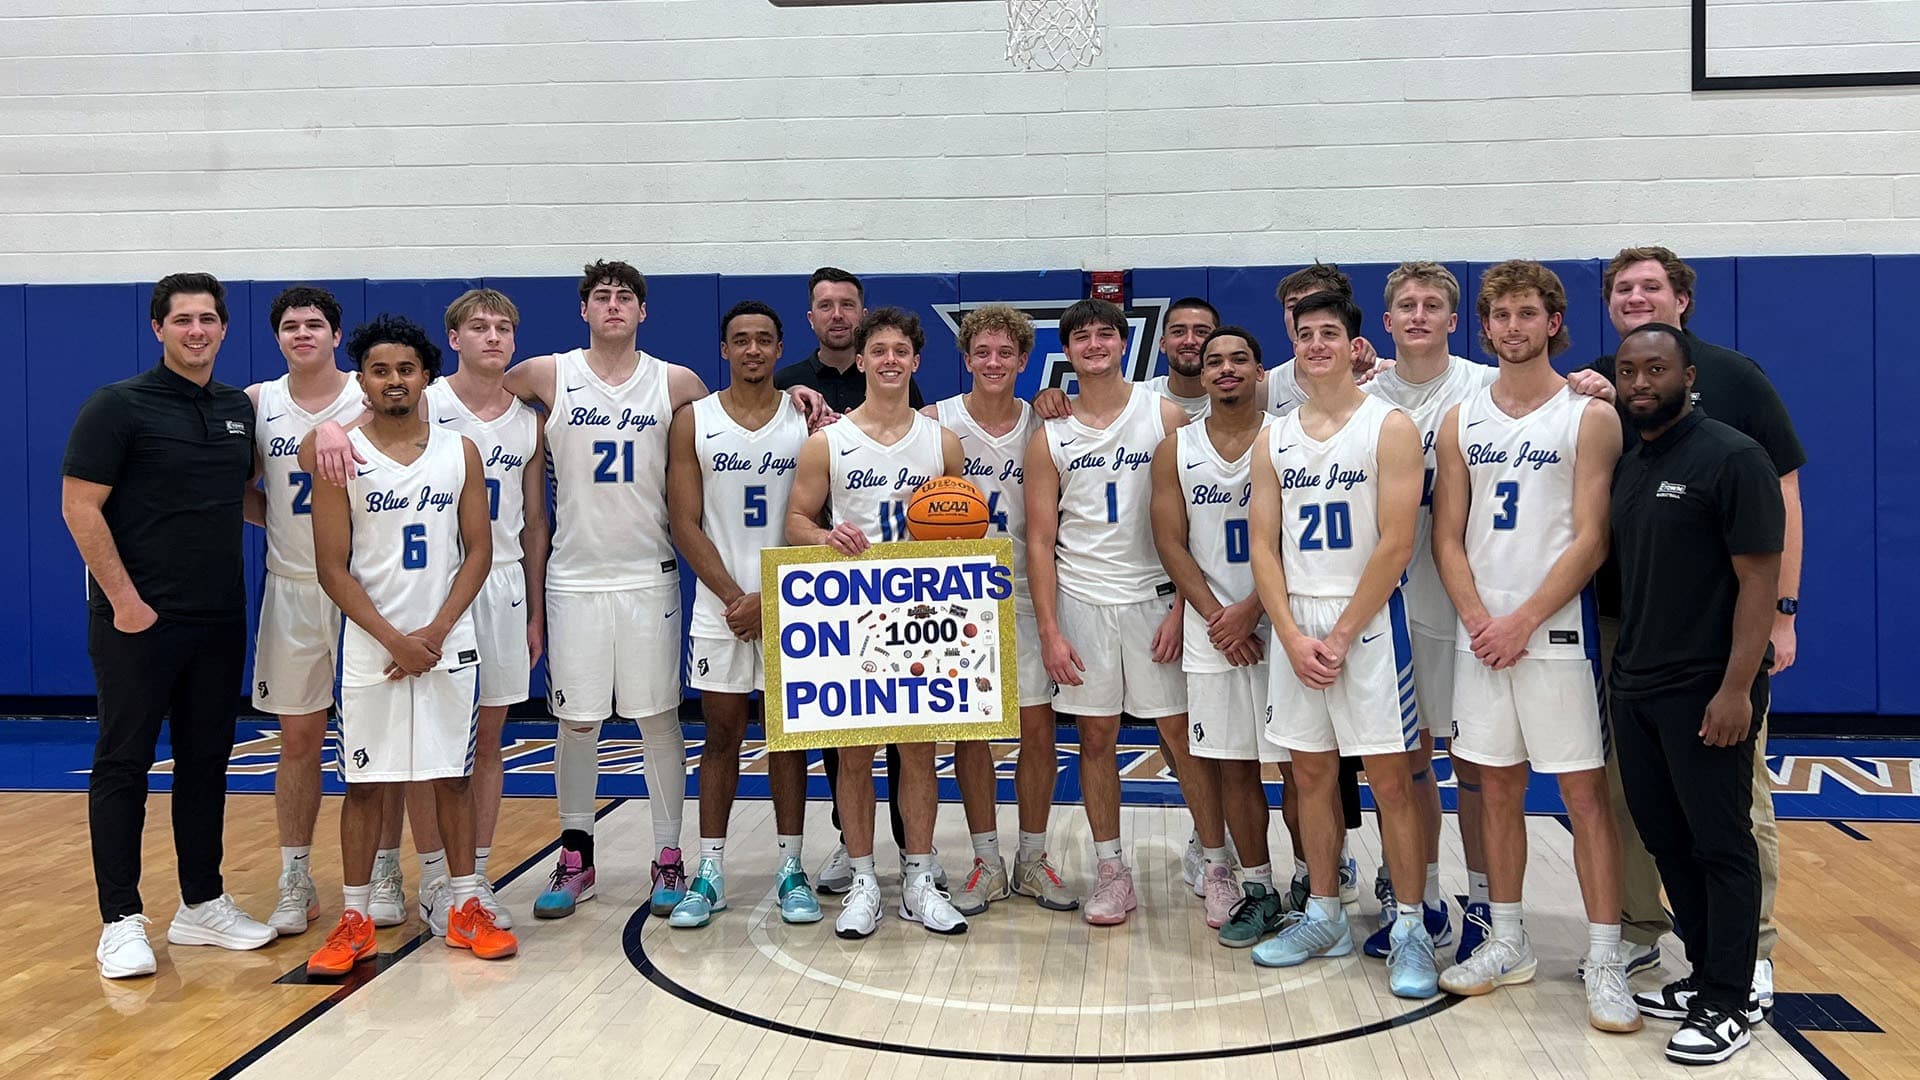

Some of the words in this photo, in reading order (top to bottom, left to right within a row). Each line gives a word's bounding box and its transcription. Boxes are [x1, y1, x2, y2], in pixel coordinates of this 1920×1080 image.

[567, 407, 611, 426] Blue
[616, 408, 657, 432] Jays
[268, 436, 299, 457] Blu
[486, 445, 523, 472] Jays
[1112, 446, 1151, 472] Jays
[1467, 442, 1508, 466] Blue
[1513, 441, 1561, 471] Jays
[592, 440, 635, 484] 21
[712, 452, 752, 472] Blue
[758, 451, 797, 476] Jays
[1282, 467, 1321, 490] Blue
[1325, 463, 1367, 491] Jays
[288, 471, 313, 515] 2
[845, 468, 887, 490] Blue
[366, 489, 409, 513] Blue
[416, 485, 454, 513] Jays
[744, 485, 767, 528] 5
[928, 501, 968, 513] NCAA
[1105, 481, 1118, 524] 1
[1191, 484, 1232, 505] Blue
[1493, 480, 1520, 531] 3
[879, 501, 907, 541] 11
[1299, 501, 1353, 552] 20
[402, 523, 428, 570] 6
[1224, 519, 1250, 563] 0
[781, 562, 1013, 607] CONGRATS
[780, 620, 850, 659] ON
[885, 618, 958, 646] 1000
